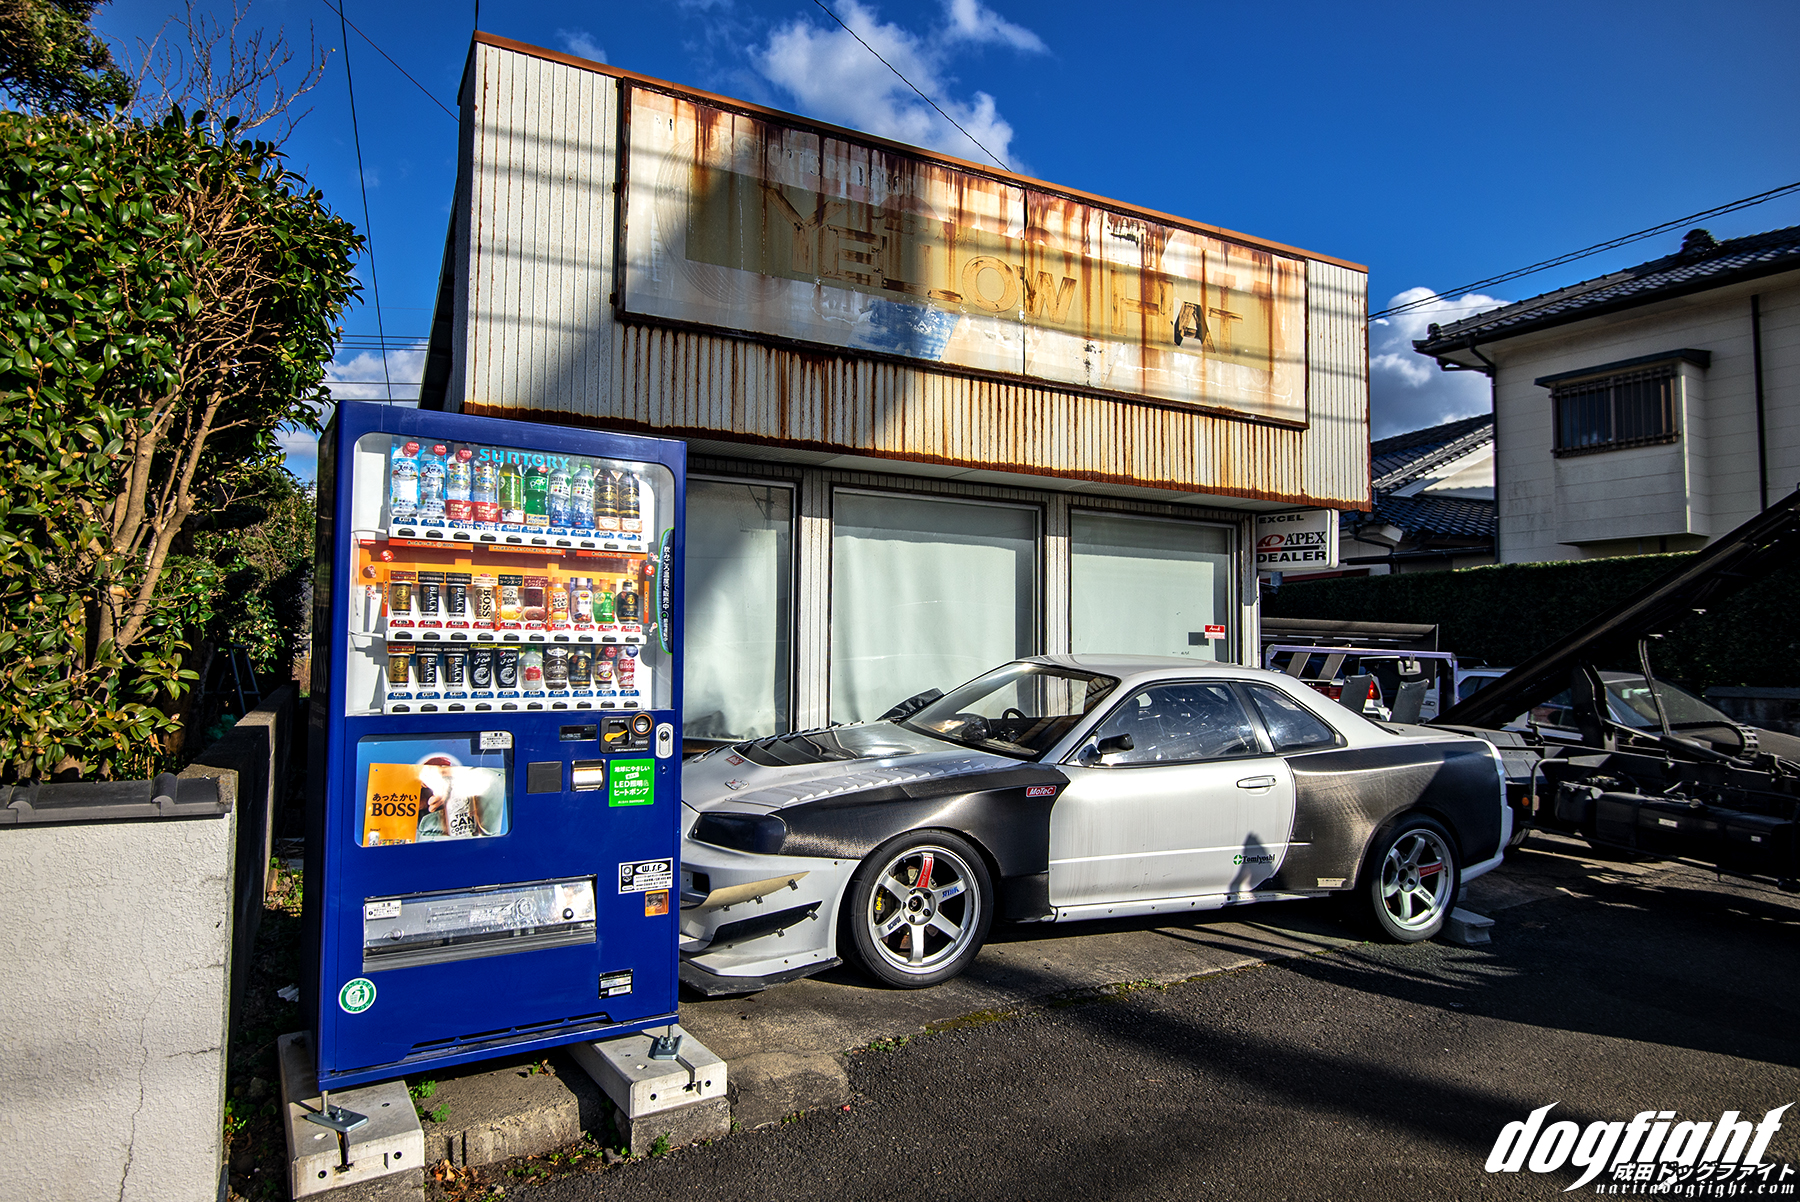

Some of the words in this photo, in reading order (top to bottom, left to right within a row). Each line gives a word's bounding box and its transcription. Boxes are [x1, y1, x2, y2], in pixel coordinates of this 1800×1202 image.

[1110, 269, 1244, 357] HAT
[479, 448, 570, 469] SUNTORY
[1258, 514, 1305, 524] EXCEL
[1257, 550, 1326, 564] DEALER
[429, 586, 438, 612] BLACK
[456, 587, 465, 612] BLACK
[482, 589, 491, 618] BOSS
[426, 657, 436, 682] BLACK
[454, 657, 463, 682] BLACK
[372, 793, 418, 803] あったかい
[613, 787, 650, 797] ヒートポンプ
[370, 802, 417, 817] BOSS
[450, 815, 476, 829] CAN
